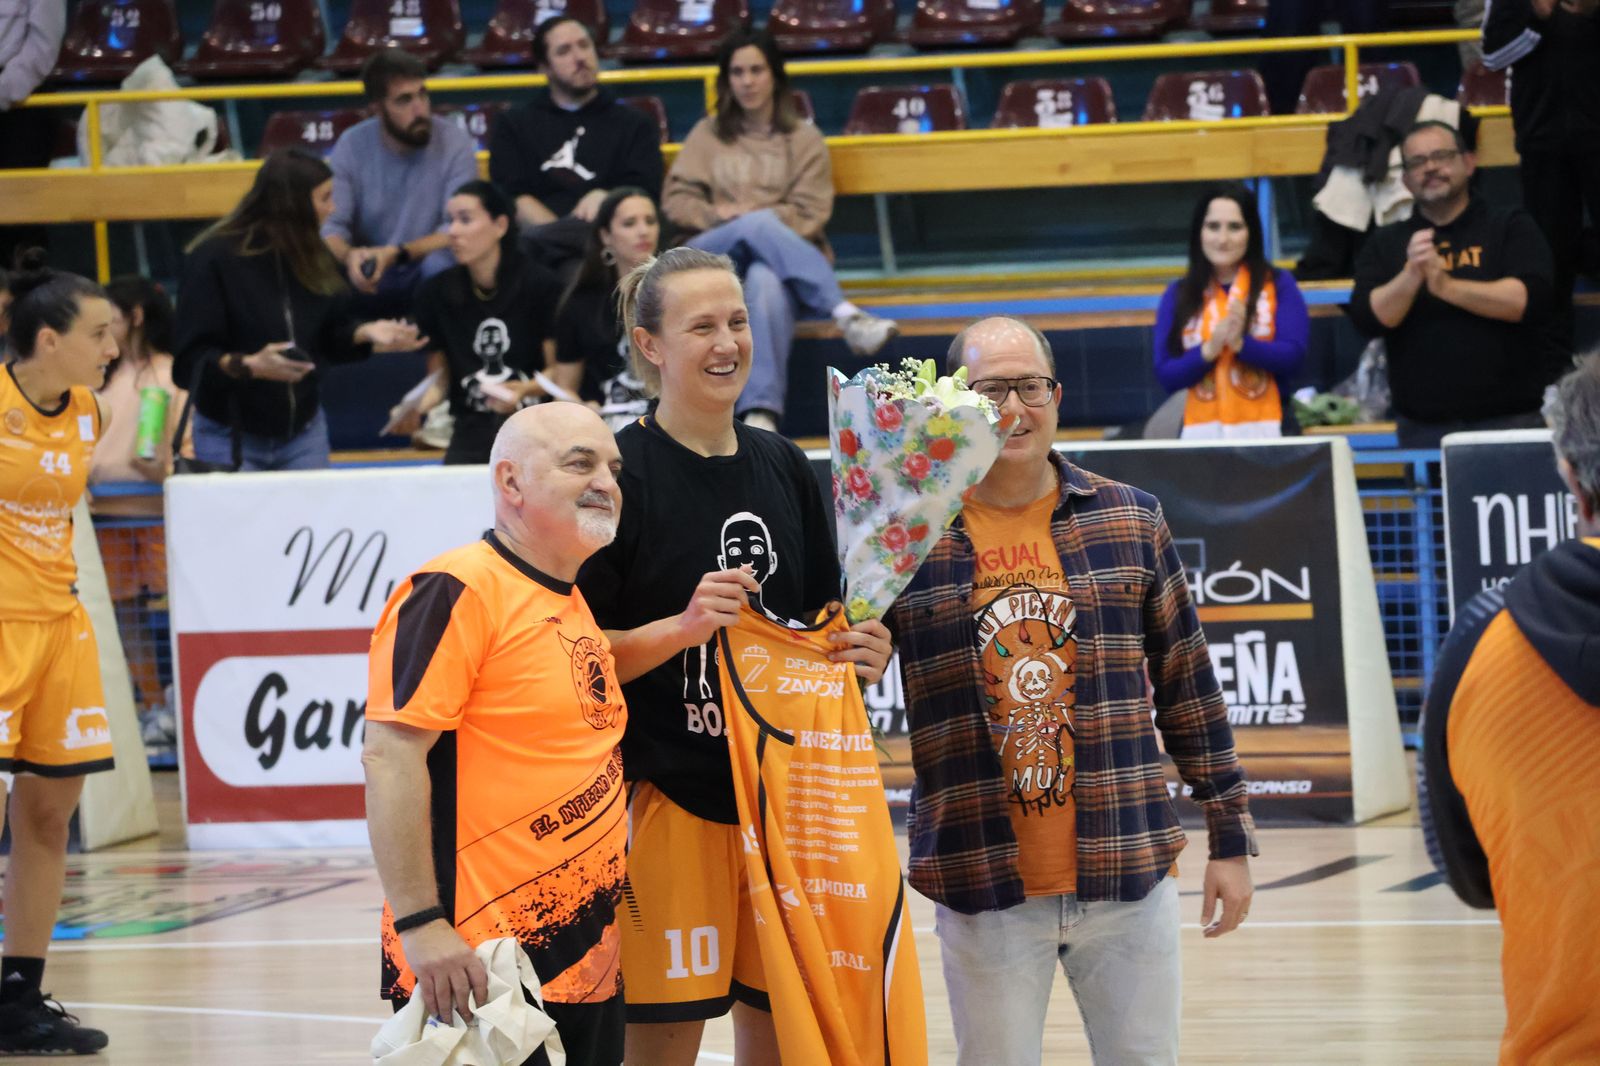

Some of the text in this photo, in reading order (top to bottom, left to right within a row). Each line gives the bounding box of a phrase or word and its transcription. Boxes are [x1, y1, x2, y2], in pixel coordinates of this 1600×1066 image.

[40, 451, 72, 475] 44
[530, 814, 559, 841] EL
[664, 926, 720, 979] 10
